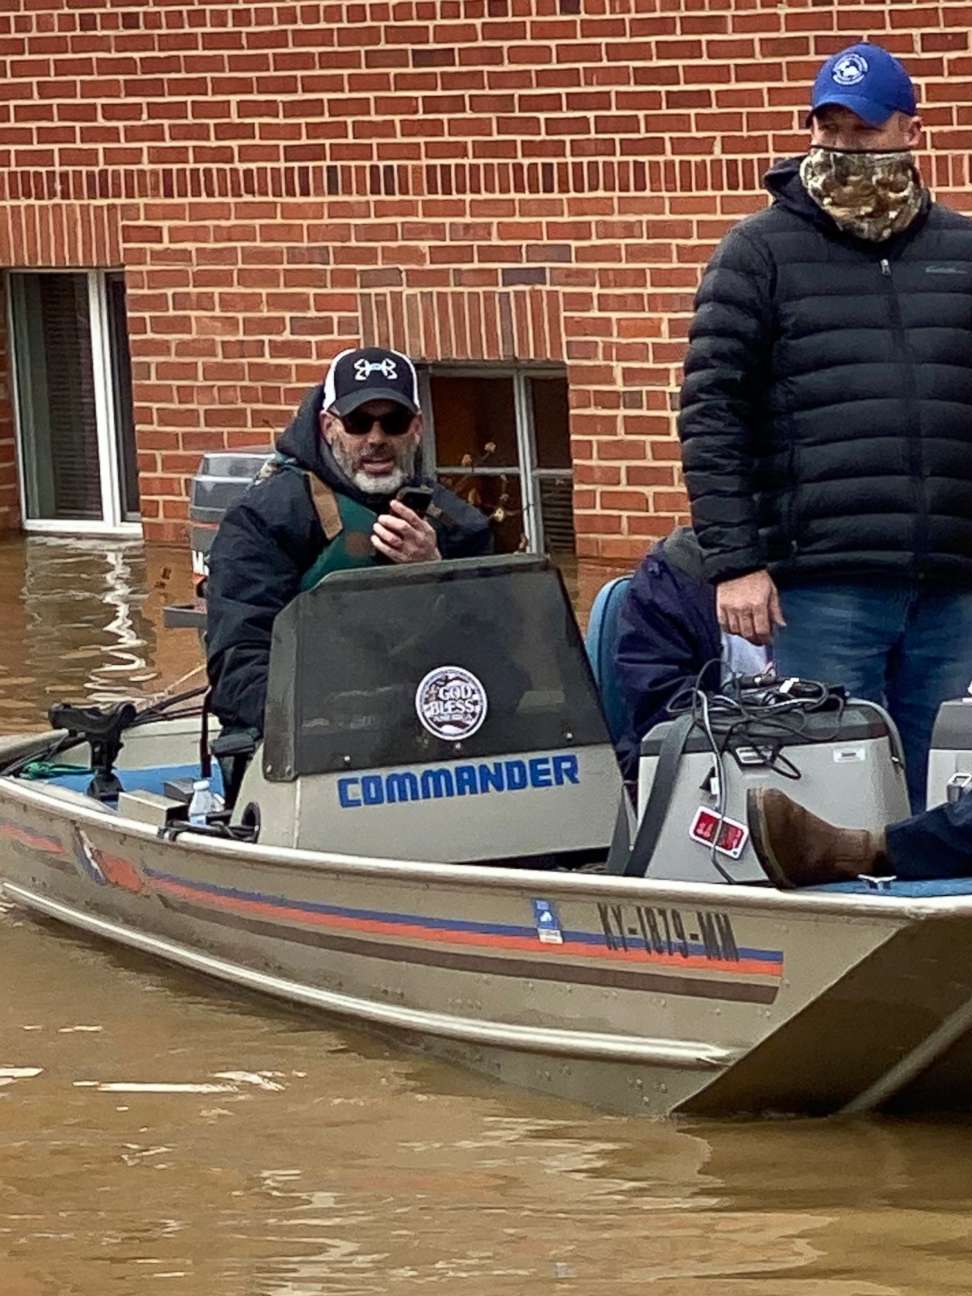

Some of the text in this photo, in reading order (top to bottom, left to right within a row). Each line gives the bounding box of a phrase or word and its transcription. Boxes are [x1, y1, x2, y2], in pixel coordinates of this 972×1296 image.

[438, 685, 472, 701] GOD
[430, 699, 475, 716] BLESS
[337, 754, 580, 809] COMMANDER
